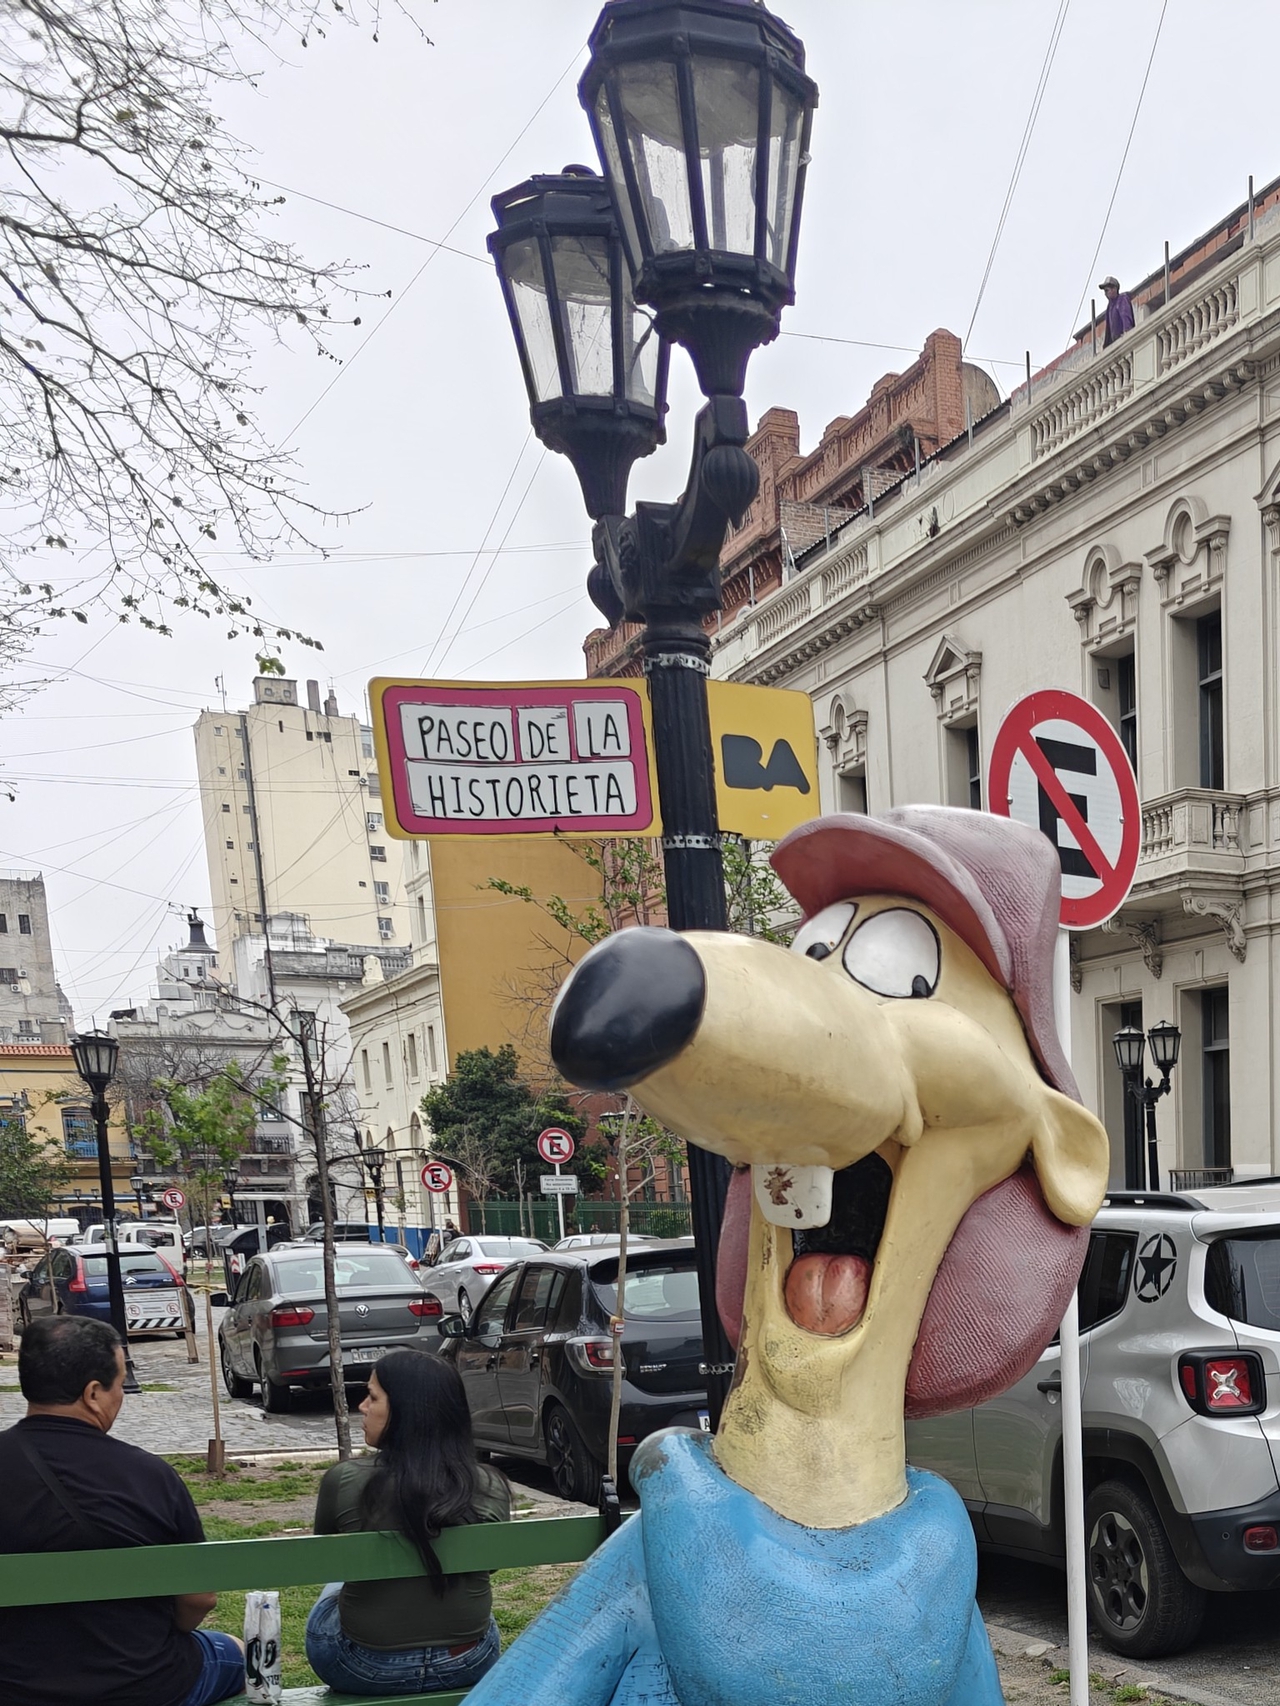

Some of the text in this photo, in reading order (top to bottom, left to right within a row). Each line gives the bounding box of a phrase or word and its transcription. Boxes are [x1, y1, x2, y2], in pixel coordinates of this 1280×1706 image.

[417, 713, 621, 760] PASEO DE LA
[720, 733, 811, 796] BA
[427, 772, 626, 819] HISTORIETA
